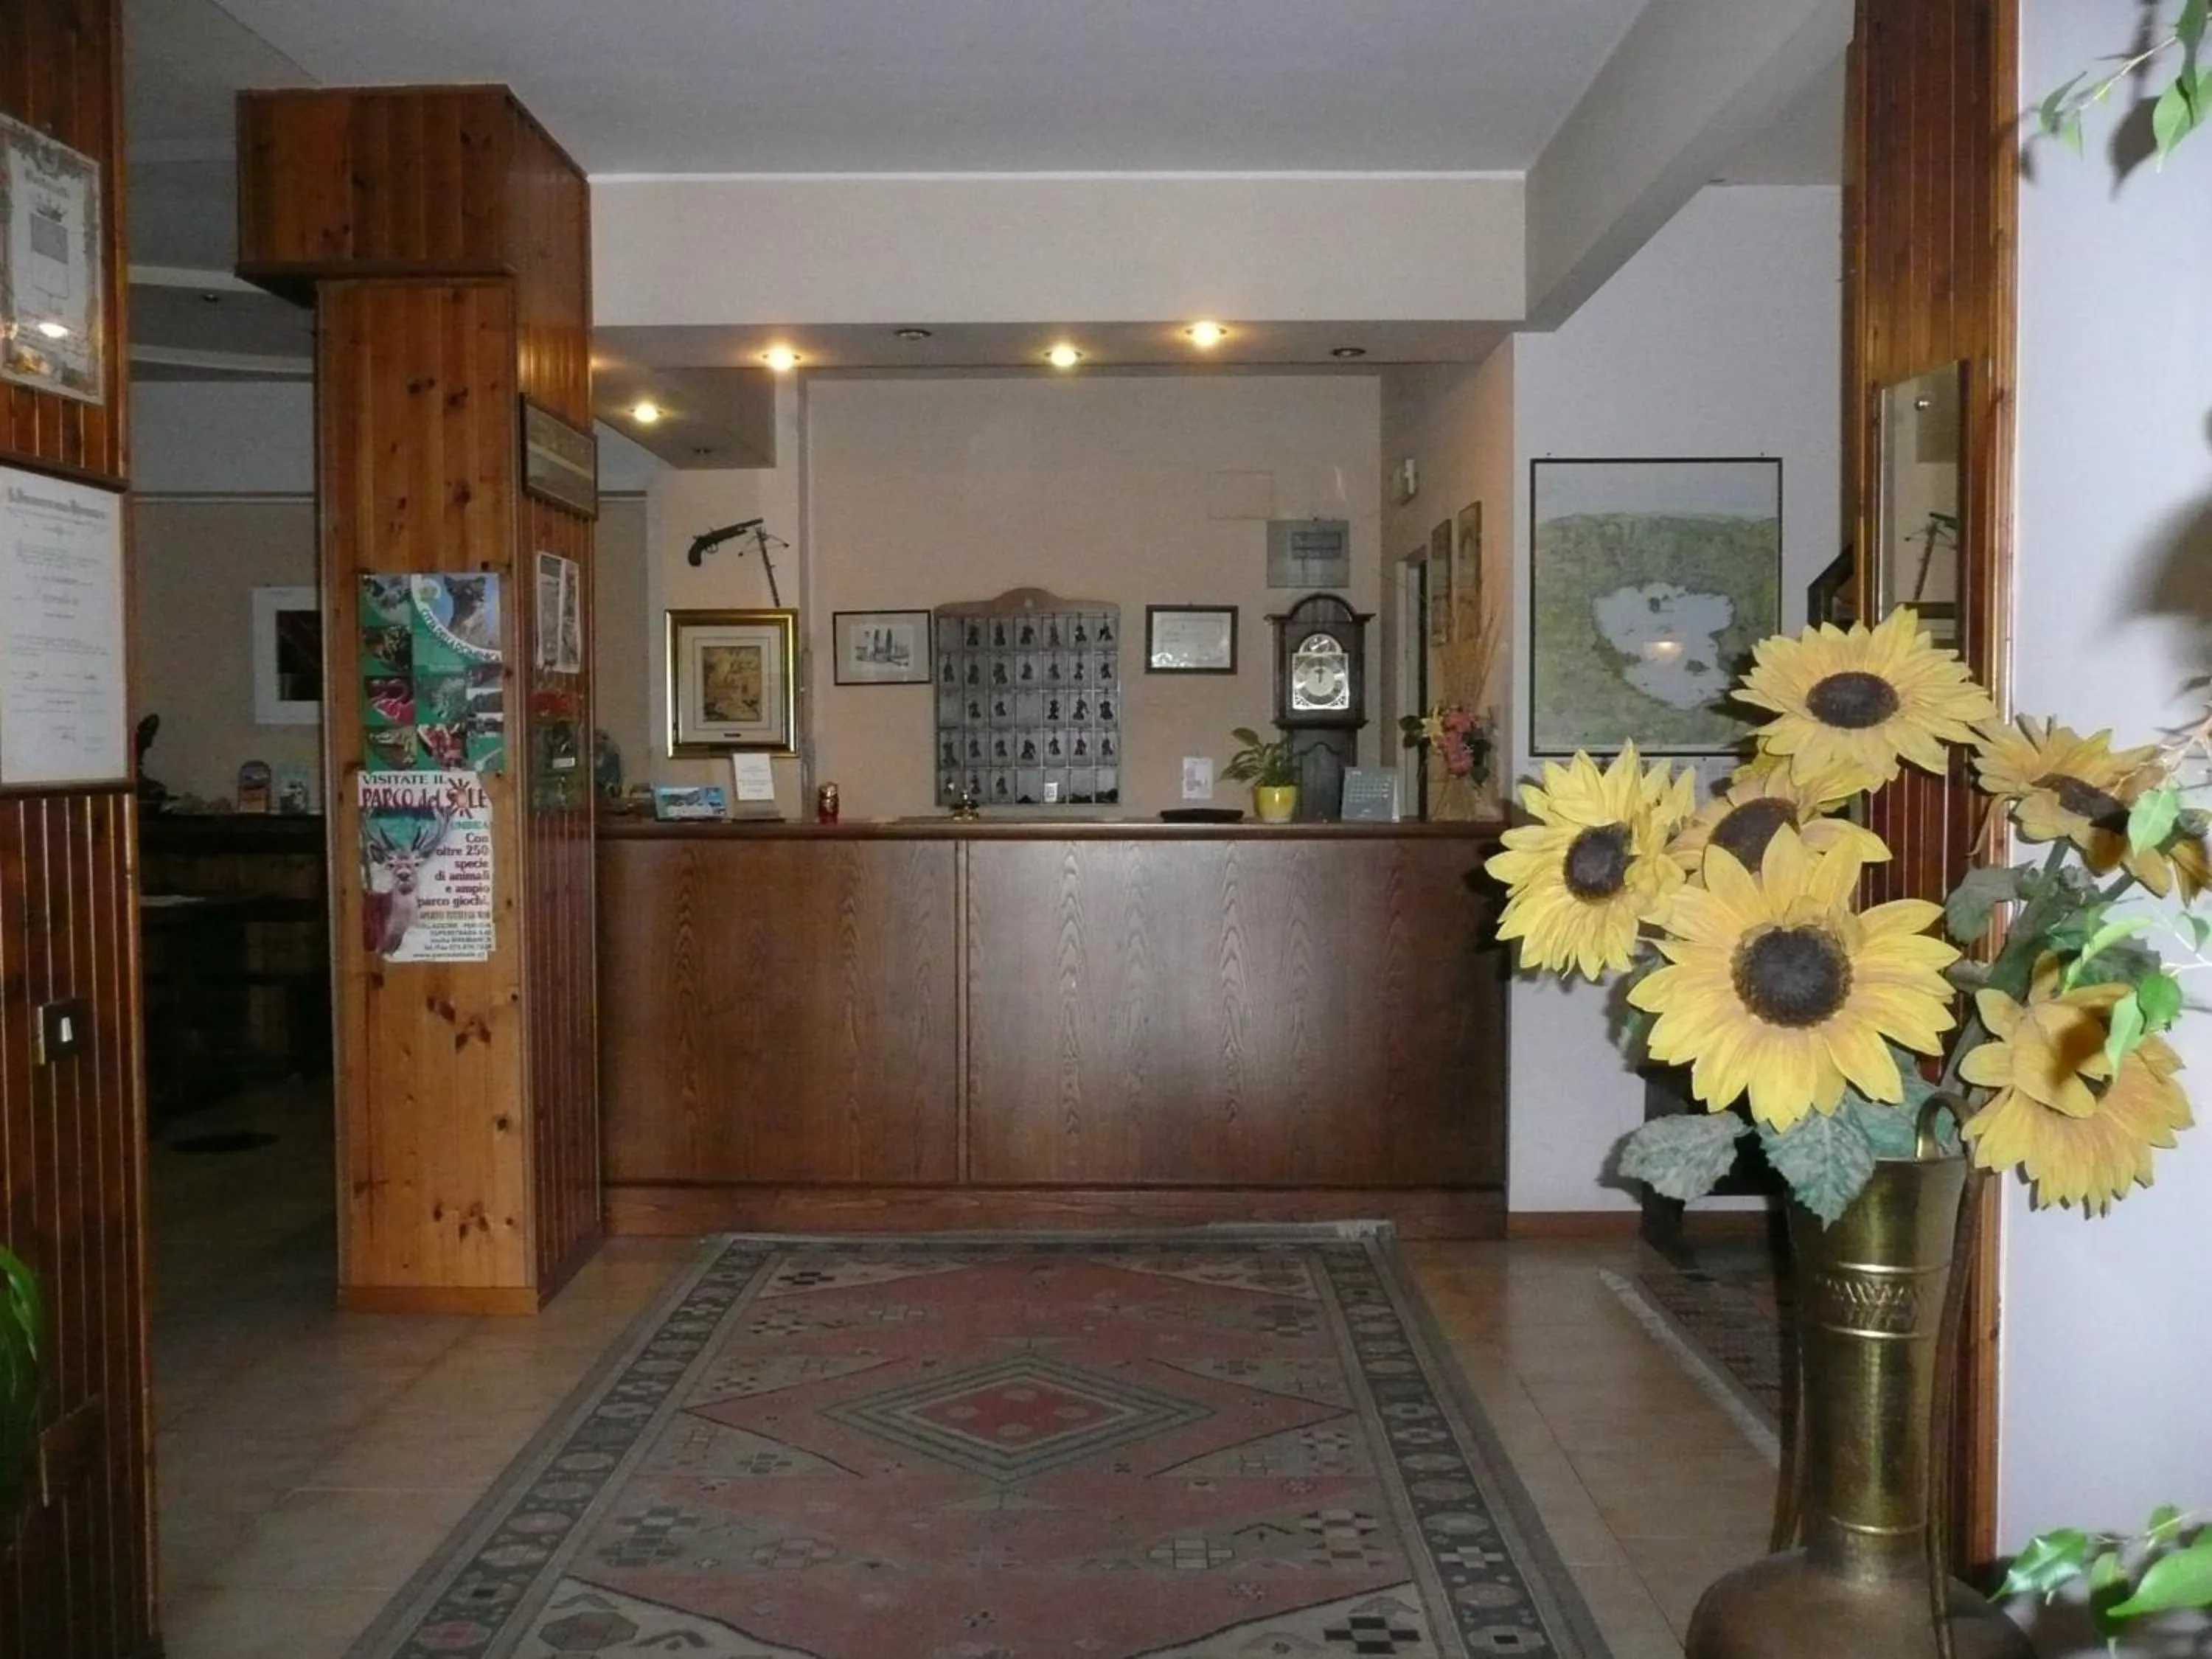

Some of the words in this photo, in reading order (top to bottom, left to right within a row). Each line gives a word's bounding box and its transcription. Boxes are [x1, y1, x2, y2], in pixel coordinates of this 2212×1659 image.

[363, 775, 428, 785] VISITATE
[362, 787, 414, 809] PARCO
[418, 788, 441, 809] del
[465, 832, 489, 843] Con
[436, 846, 462, 855] oltre
[466, 845, 489, 855] 250
[454, 858, 489, 870] specie
[434, 870, 445, 881] di
[449, 870, 490, 881] animali
[455, 883, 490, 895] ampio
[417, 897, 450, 908] parco
